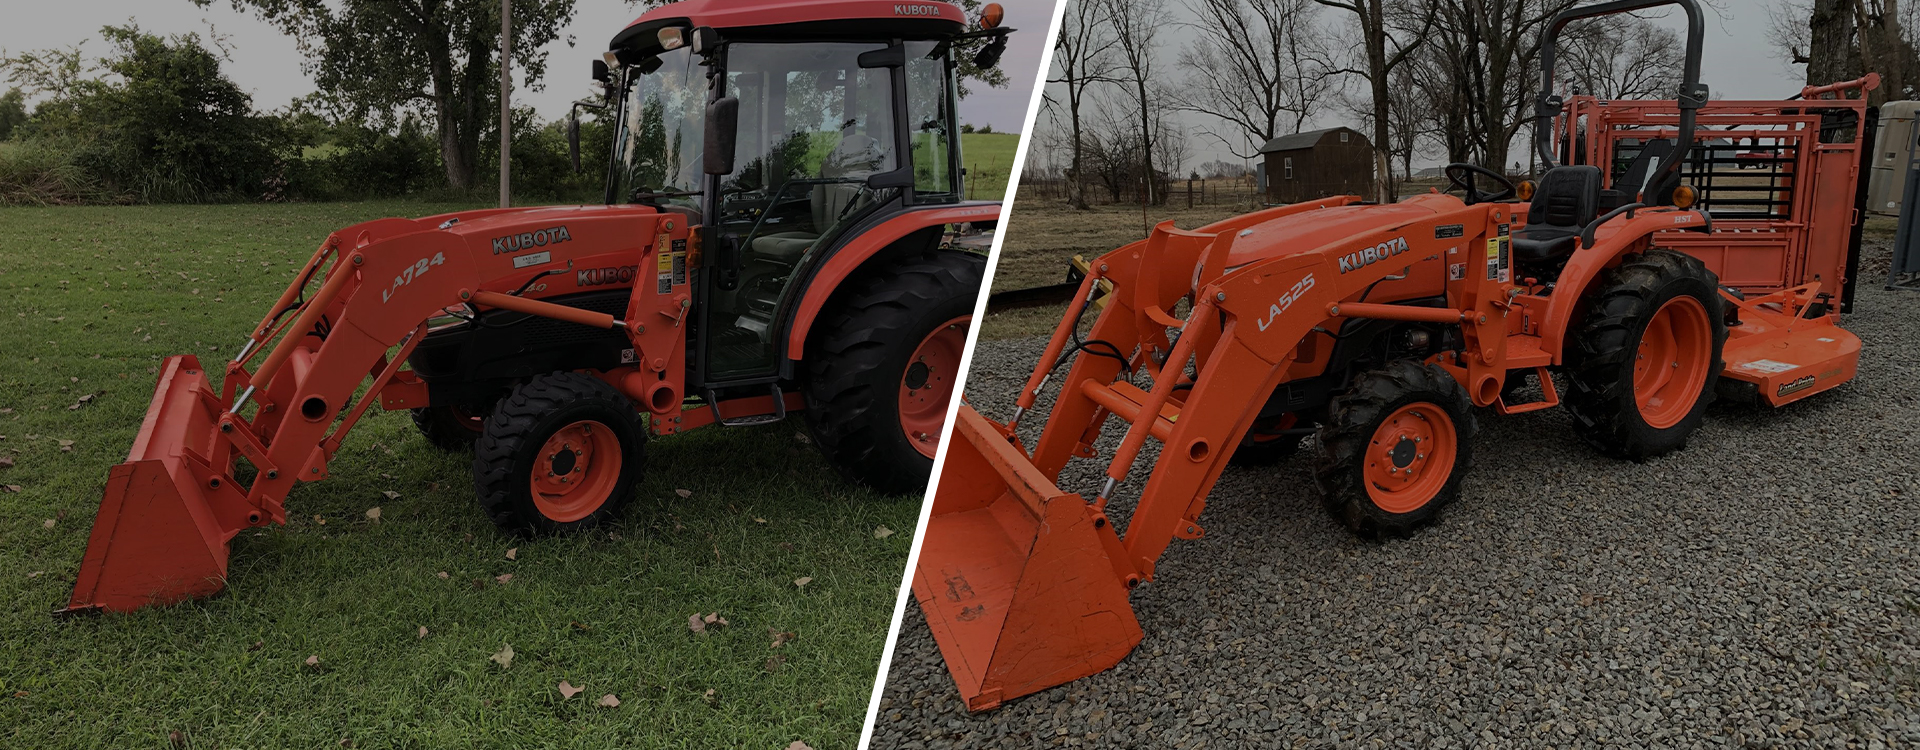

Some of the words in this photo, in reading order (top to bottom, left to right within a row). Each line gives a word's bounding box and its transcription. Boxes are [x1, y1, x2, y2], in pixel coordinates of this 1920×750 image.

[894, 4, 939, 15] KUBOTA
[1674, 215, 1692, 223] HST
[492, 225, 572, 255] KUBOTA
[1338, 236, 1410, 274] KUBOTA
[382, 251, 446, 304] LA724
[577, 265, 639, 287] KUBOT
[1256, 272, 1316, 332] LA525
